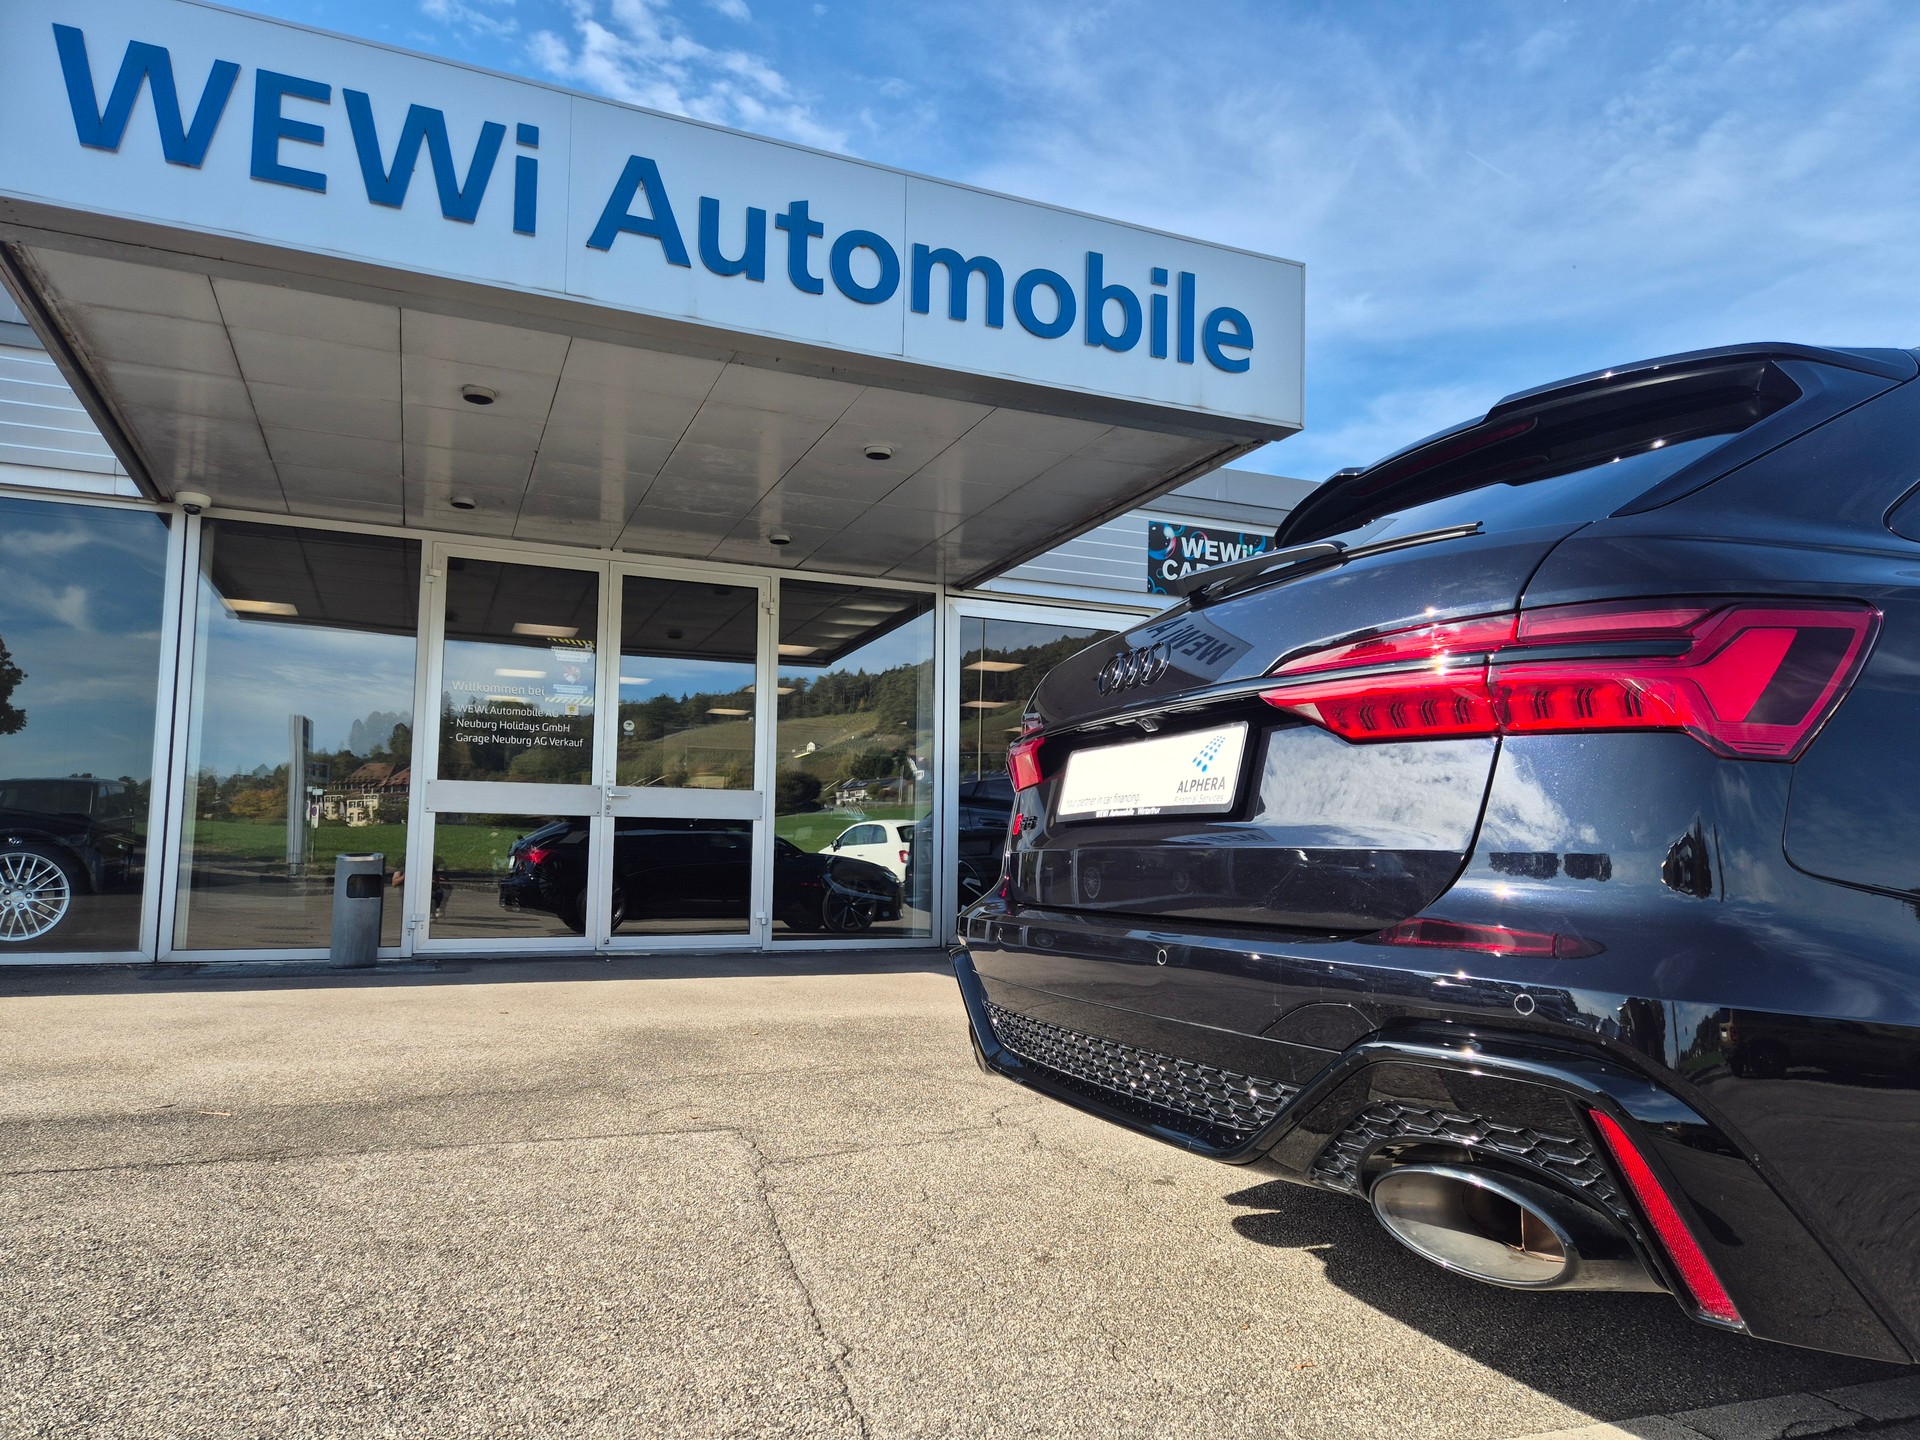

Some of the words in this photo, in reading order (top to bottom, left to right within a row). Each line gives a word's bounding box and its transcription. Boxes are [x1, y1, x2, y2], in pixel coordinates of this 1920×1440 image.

[52, 22, 539, 237] WEWi
[586, 154, 1254, 374] Automobile
[452, 681, 525, 695] Willkommen
[528, 685, 545, 696] bei
[489, 705, 544, 718] Automobile
[545, 709, 559, 718] AG
[456, 718, 497, 731] Neuburg
[499, 721, 540, 733] Holidays
[541, 722, 571, 733] GmbH
[455, 733, 490, 745] Garage
[492, 734, 532, 747] Neuburg
[533, 736, 547, 746] AG
[548, 737, 584, 747] Verkauf
[1176, 776, 1226, 793] ALPHERA
